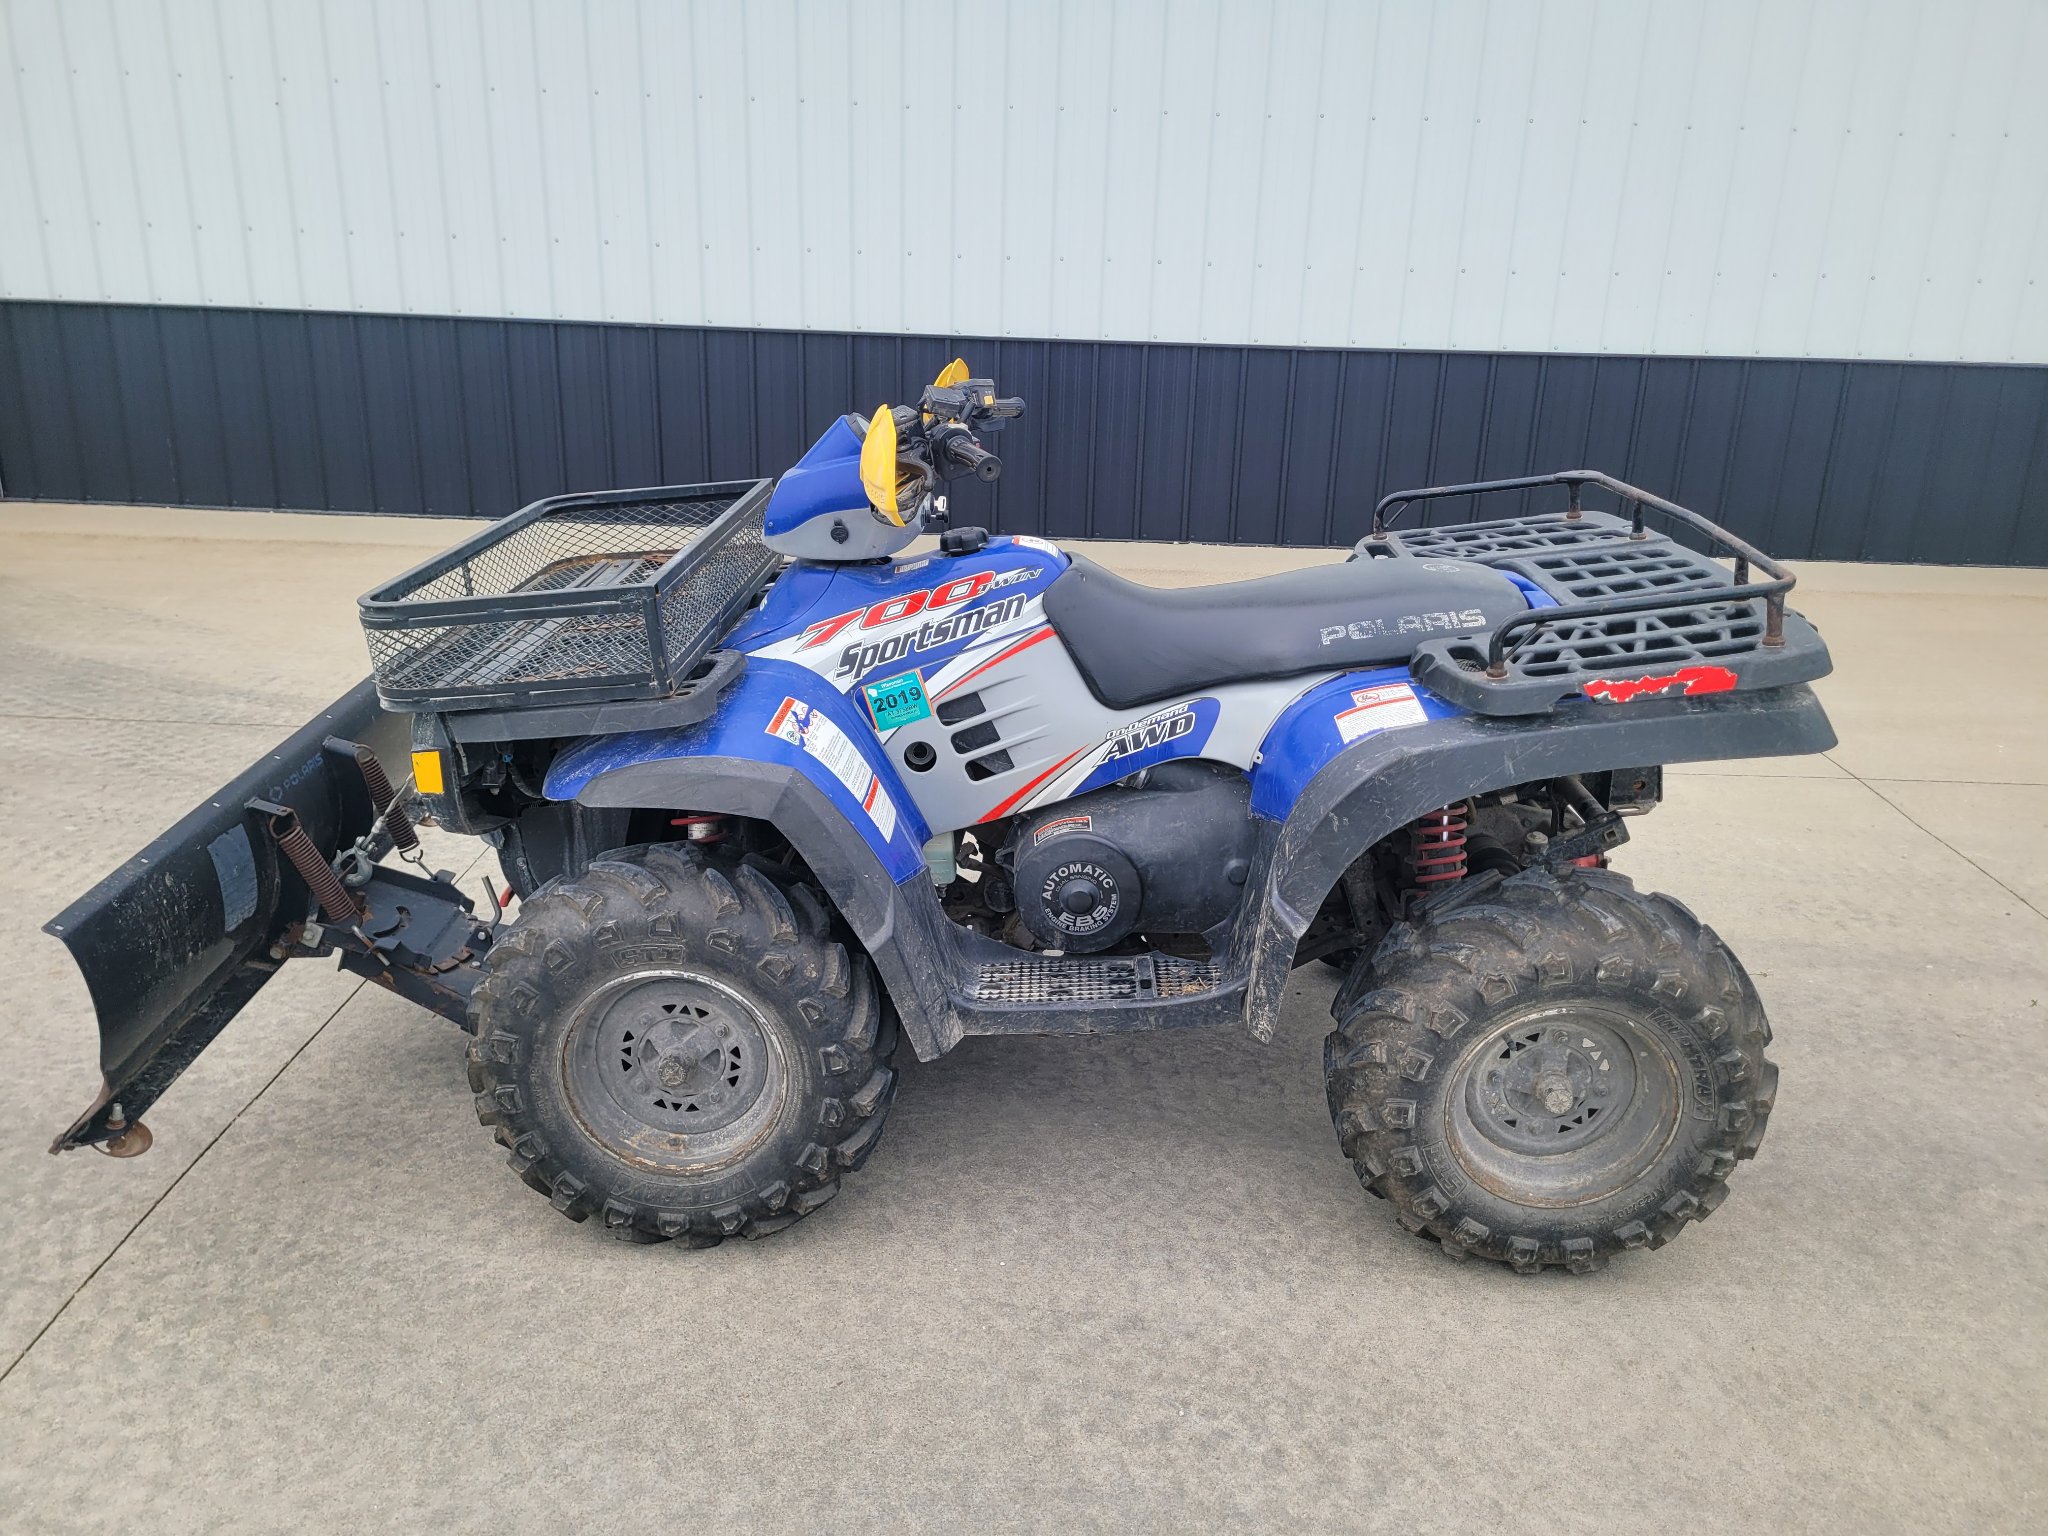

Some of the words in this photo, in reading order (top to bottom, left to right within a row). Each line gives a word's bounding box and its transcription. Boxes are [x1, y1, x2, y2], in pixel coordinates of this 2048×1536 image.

[794, 570, 997, 653] 700
[975, 567, 1043, 596] TWIN
[833, 593, 1027, 683] Sportsman
[873, 686, 922, 713] 2019
[1096, 711, 1196, 765] AWD
[283, 752, 324, 788] POLARIS
[1042, 863, 1114, 900] AUTOMATIC
[1044, 907, 1067, 929] ENGINE
[1068, 920, 1104, 932] BRAKING
[1102, 893, 1117, 922] SYSTEM
[1058, 905, 1108, 927] EBS
